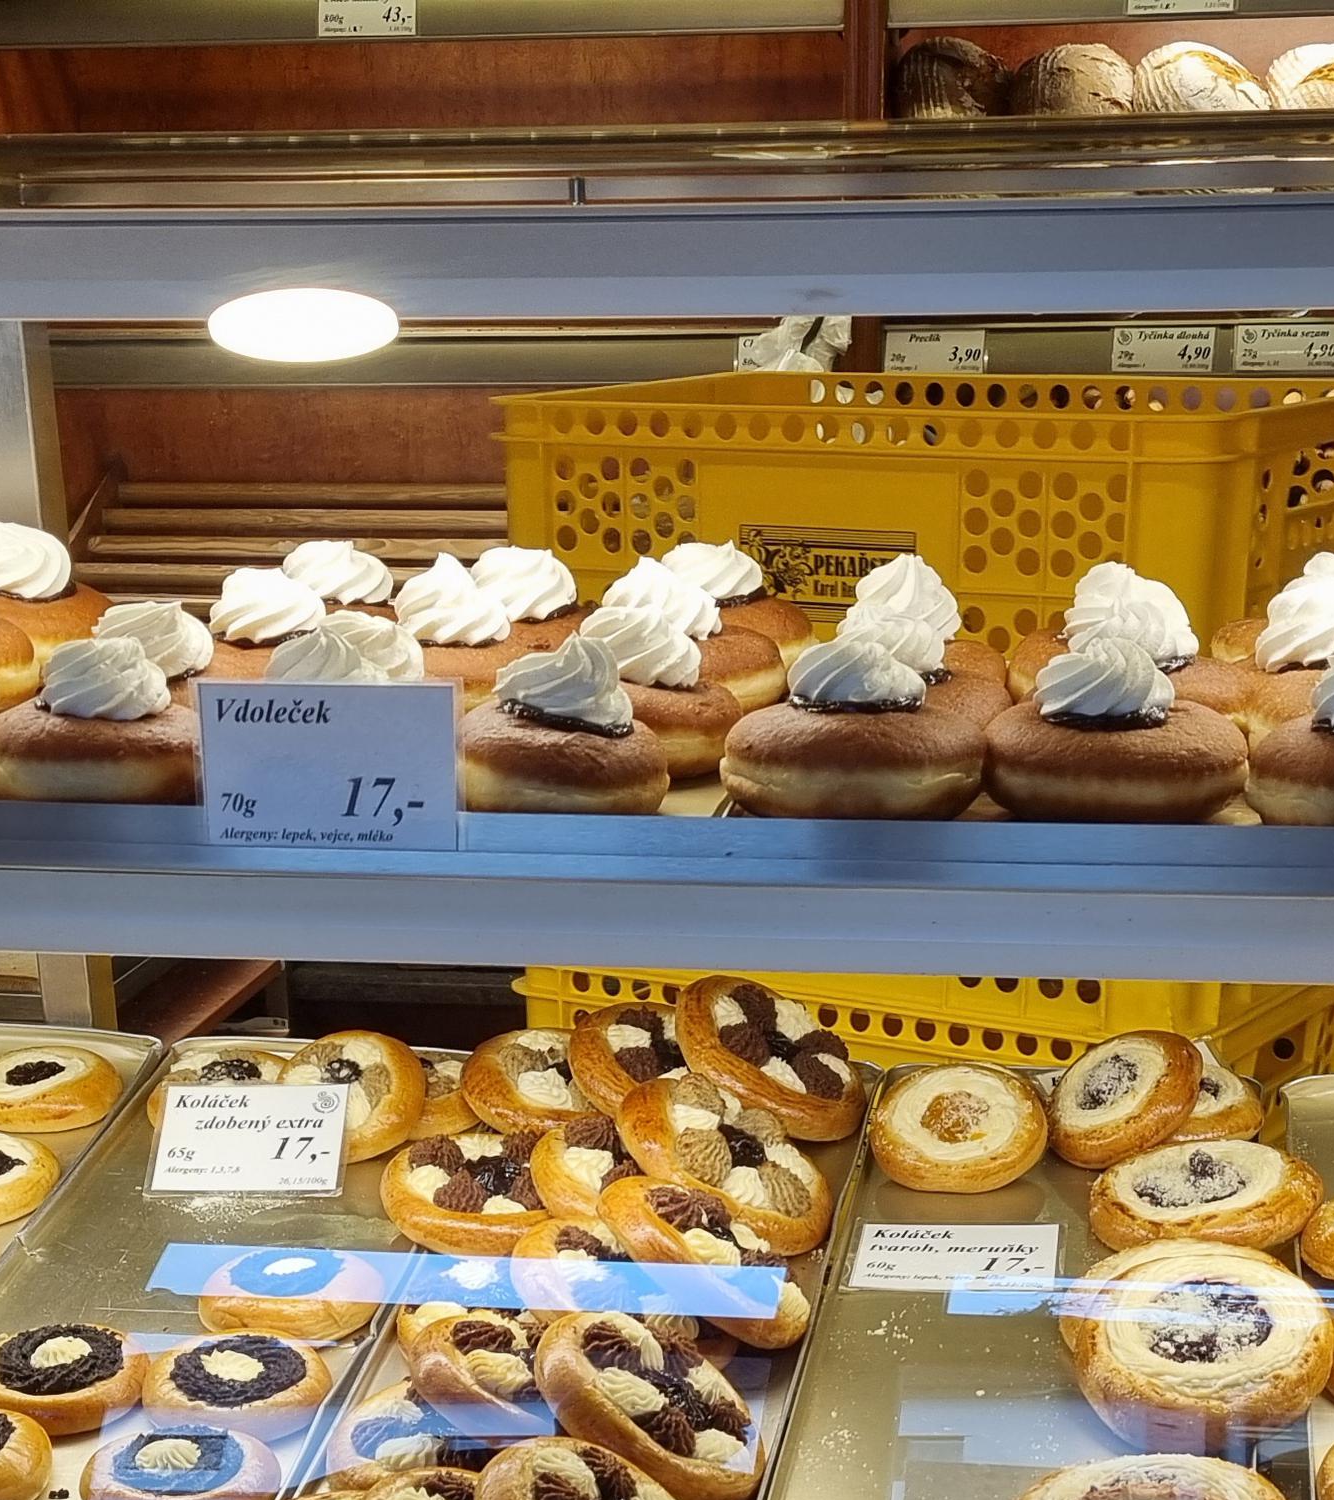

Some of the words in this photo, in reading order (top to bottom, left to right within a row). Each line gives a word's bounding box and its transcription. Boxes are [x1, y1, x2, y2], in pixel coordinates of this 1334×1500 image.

[382, 6, 412, 24] 43,-
[1138, 331, 1174, 341] Tyčinka
[1177, 330, 1209, 340] dlouhá
[1261, 329, 1298, 339] Tyčinka
[949, 346, 981, 364] 3,90
[1177, 344, 1211, 362] 4,90
[813, 552, 892, 577] PEKAŘS
[216, 698, 331, 724] Vdoleček
[221, 793, 257, 818] 70g
[341, 776, 424, 826] 17,-
[220, 827, 278, 842] Alergeny:
[281, 827, 317, 842] lepek,
[320, 830, 354, 842] vejce,
[357, 829, 393, 842] mléko
[175, 1094, 251, 1108] Koláček
[195, 1116, 271, 1132] zdobený
[276, 1119, 324, 1129] extra
[167, 1147, 195, 1161] 65g
[270, 1137, 331, 1164] 17,-
[164, 1167, 207, 1175] Alergeny:
[872, 1229, 955, 1239] Koláček
[869, 1244, 939, 1253] tvaroh,
[947, 1244, 1039, 1255] meruňky
[866, 1262, 897, 1271] 60g
[980, 1257, 1045, 1274] 17,-
